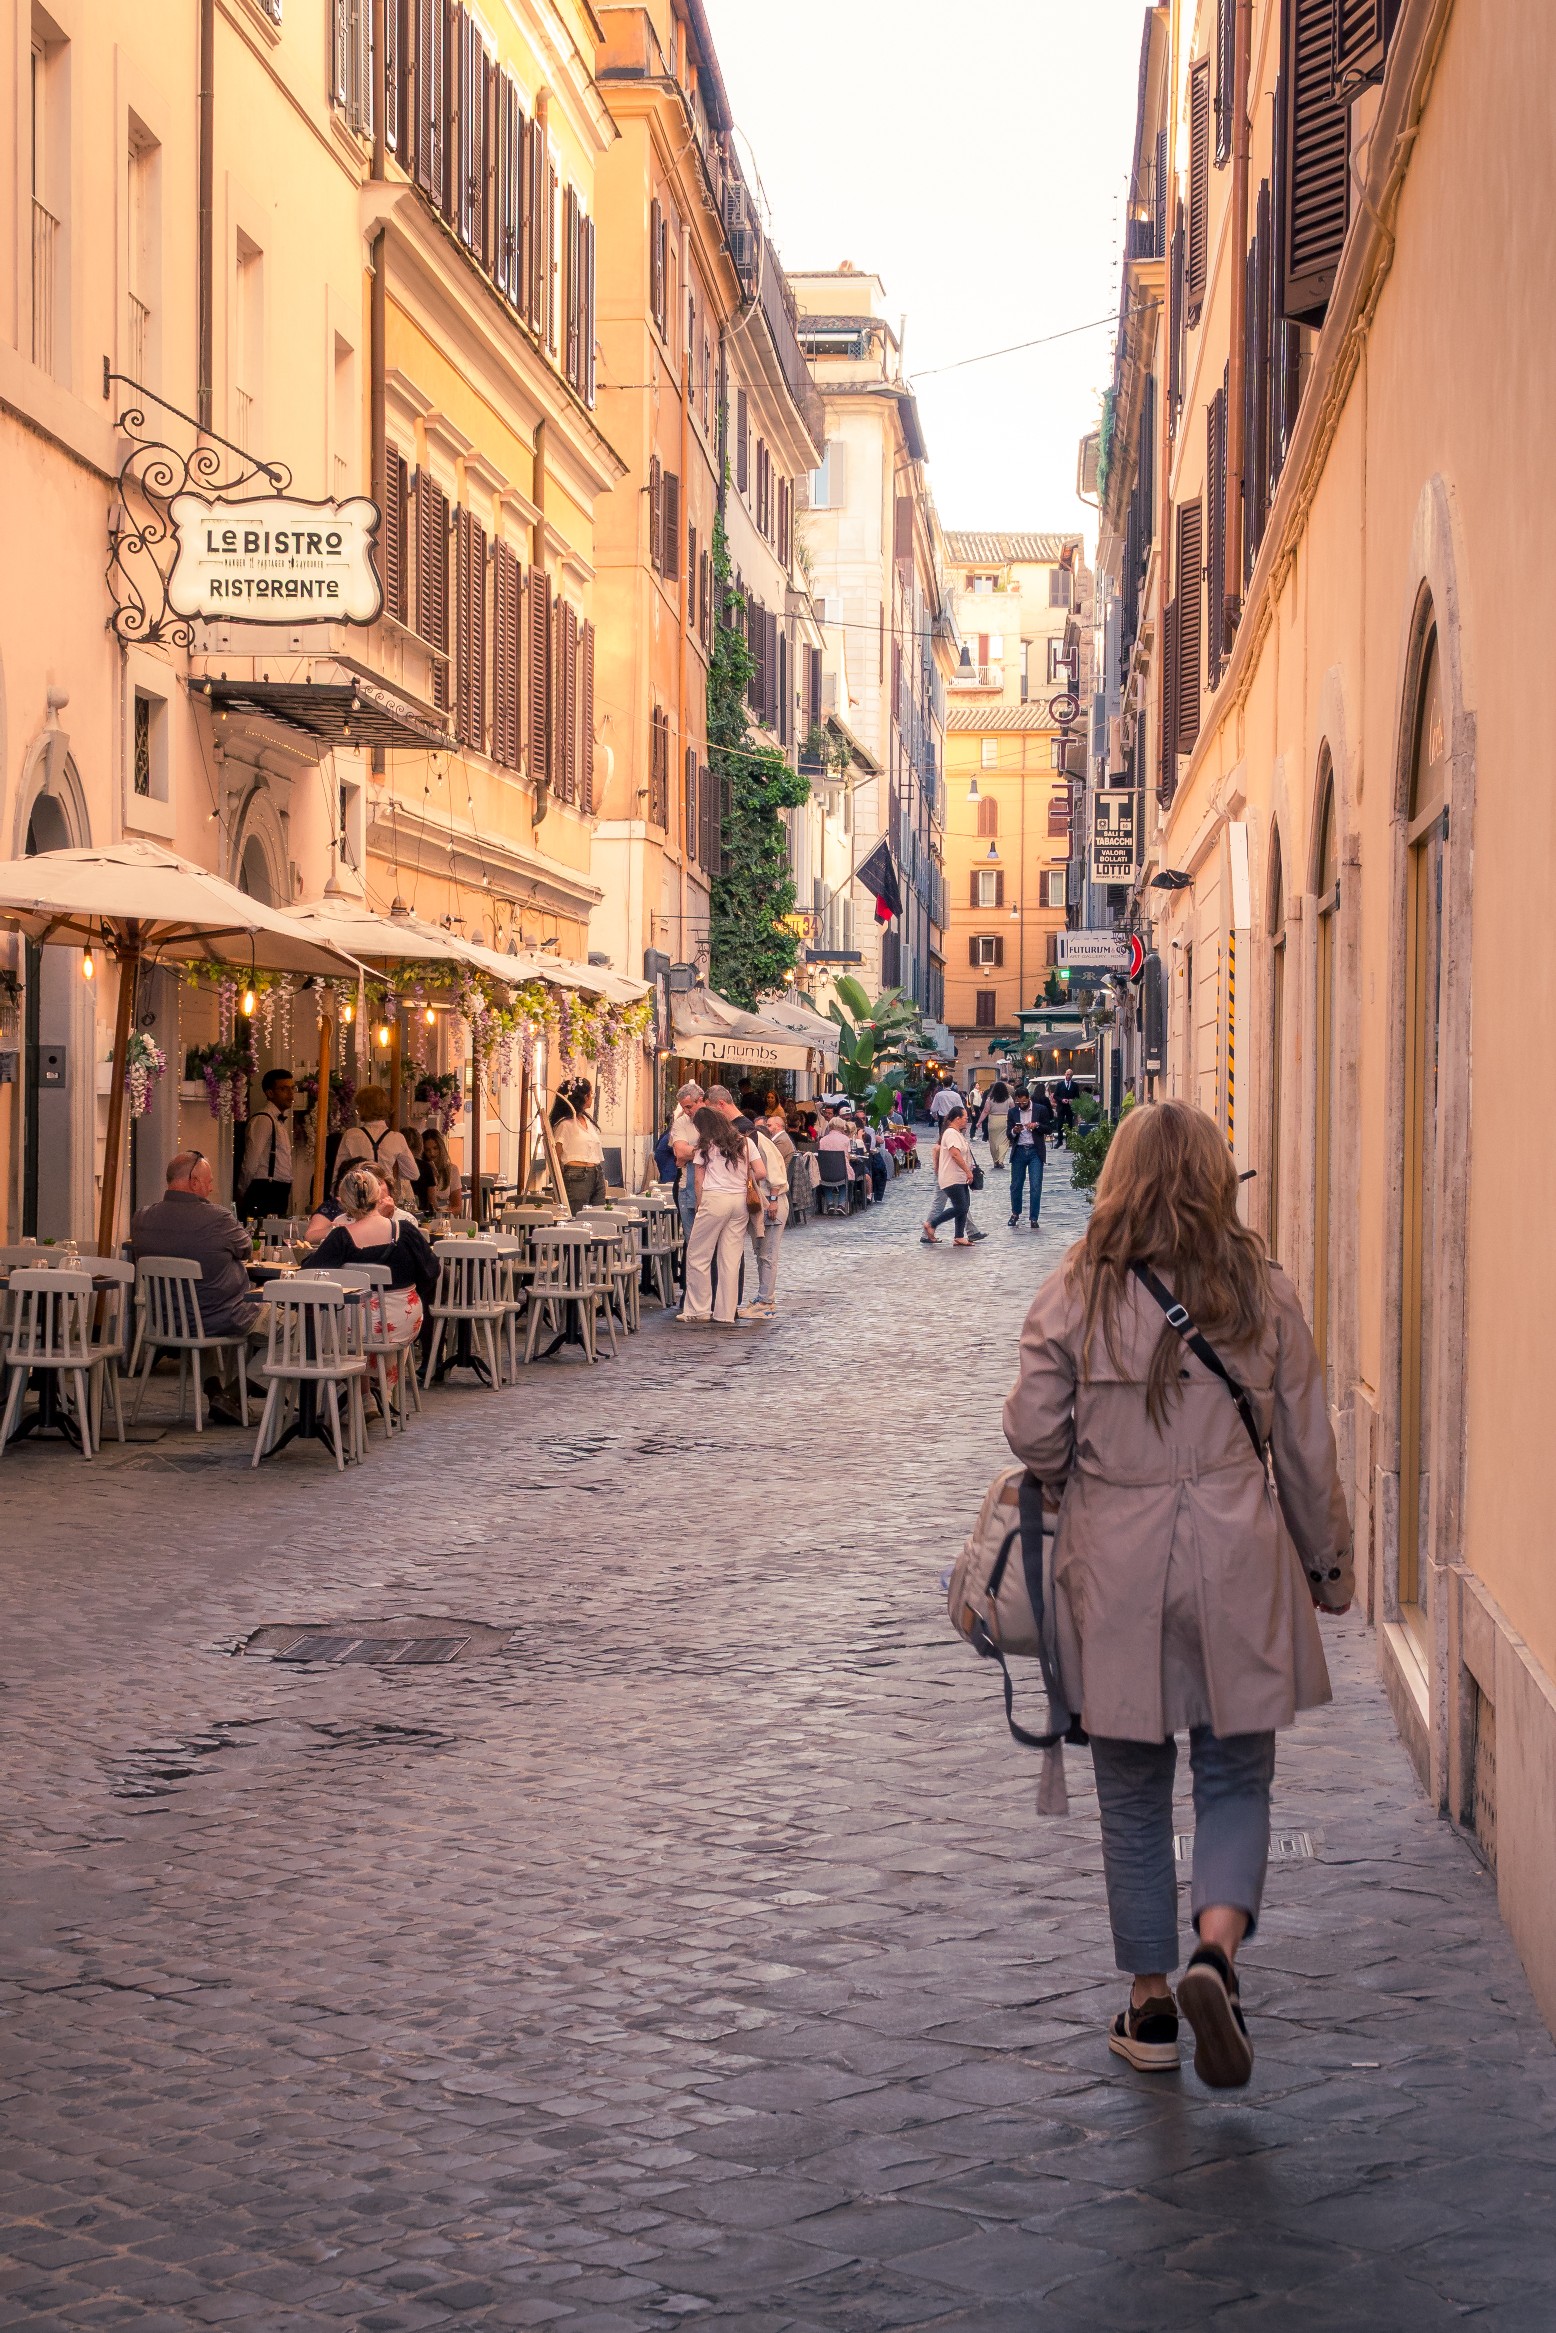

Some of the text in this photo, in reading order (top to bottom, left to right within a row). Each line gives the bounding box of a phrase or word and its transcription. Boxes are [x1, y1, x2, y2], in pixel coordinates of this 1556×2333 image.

[1100, 795, 1128, 830] T
[1096, 837, 1132, 846] TABACCHI
[1096, 865, 1131, 875] LOTTO
[802, 916, 819, 936] 34
[1069, 946, 1111, 954] FUTURISM
[727, 1045, 778, 1061] numbs
